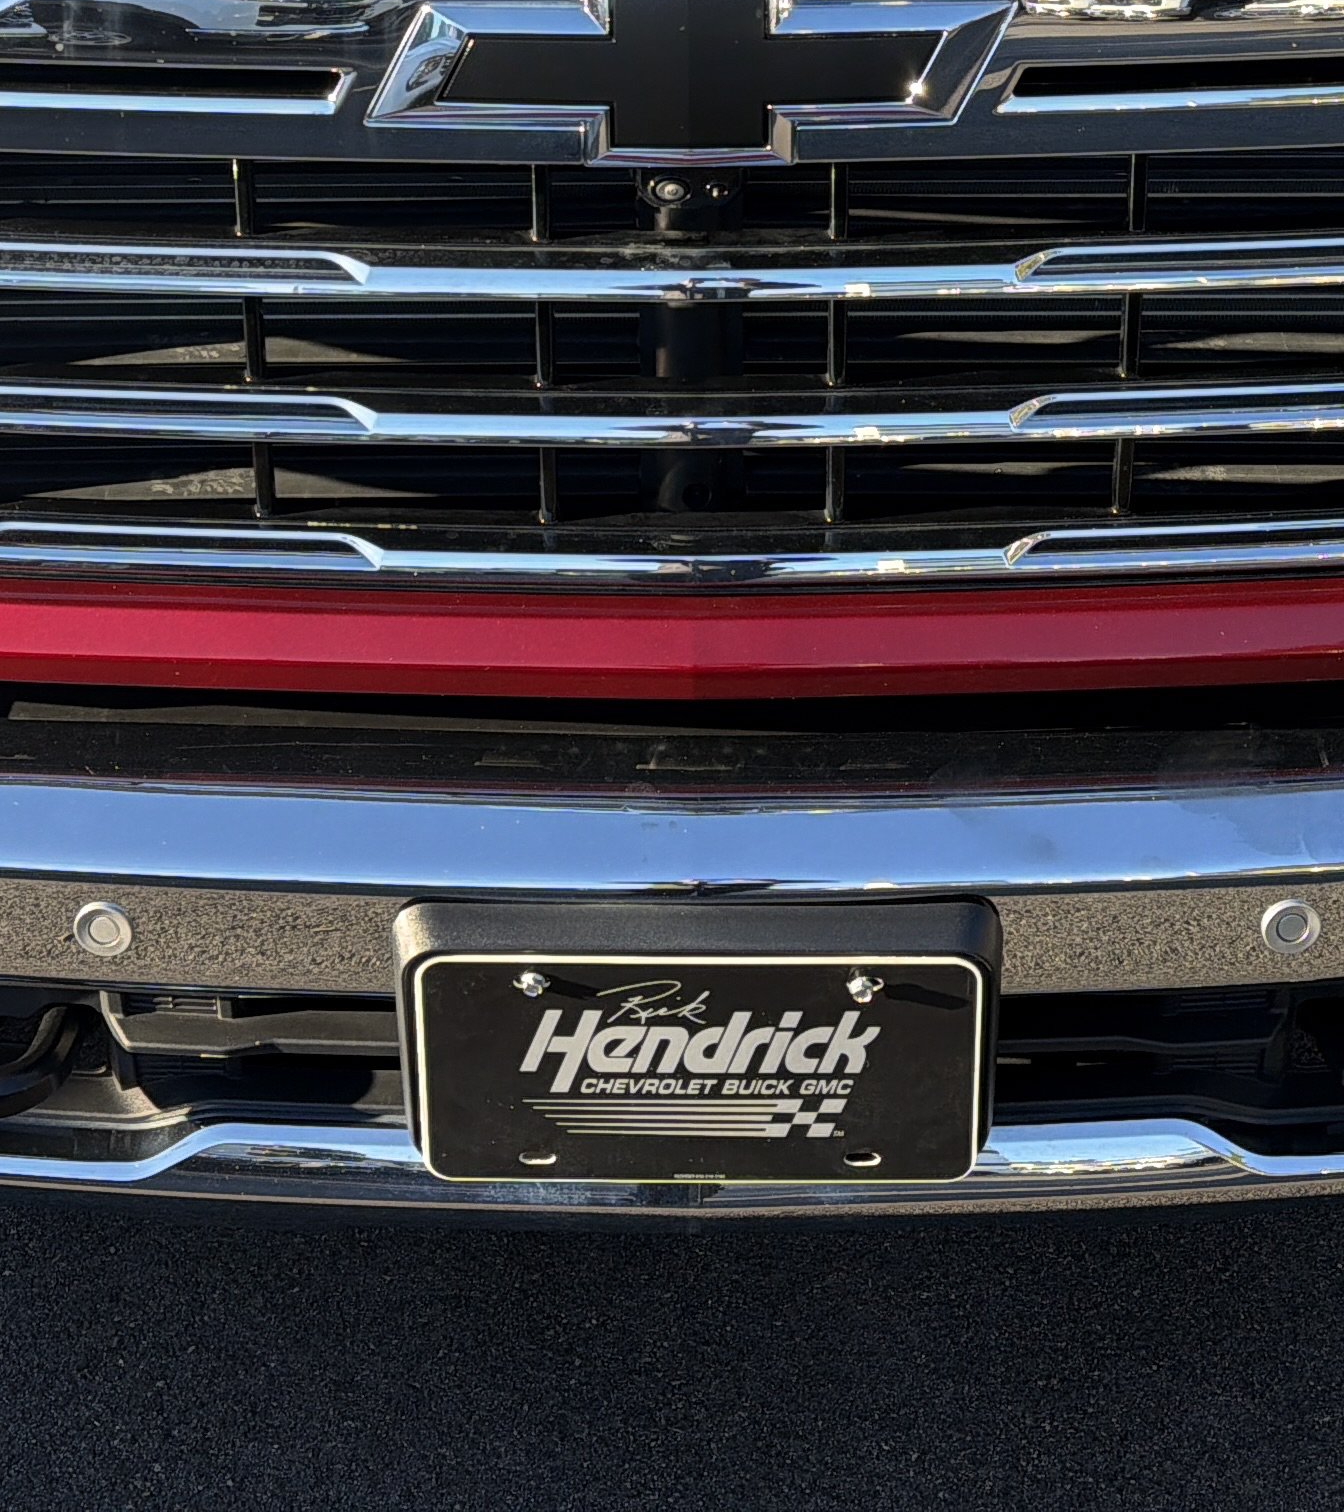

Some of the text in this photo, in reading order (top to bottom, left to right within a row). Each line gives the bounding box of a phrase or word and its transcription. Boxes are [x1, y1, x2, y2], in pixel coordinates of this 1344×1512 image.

[596, 980, 710, 1024] Rick
[519, 1009, 881, 1093] Hendrick
[580, 1078, 855, 1096] CHEVROLET BUICK GMC
